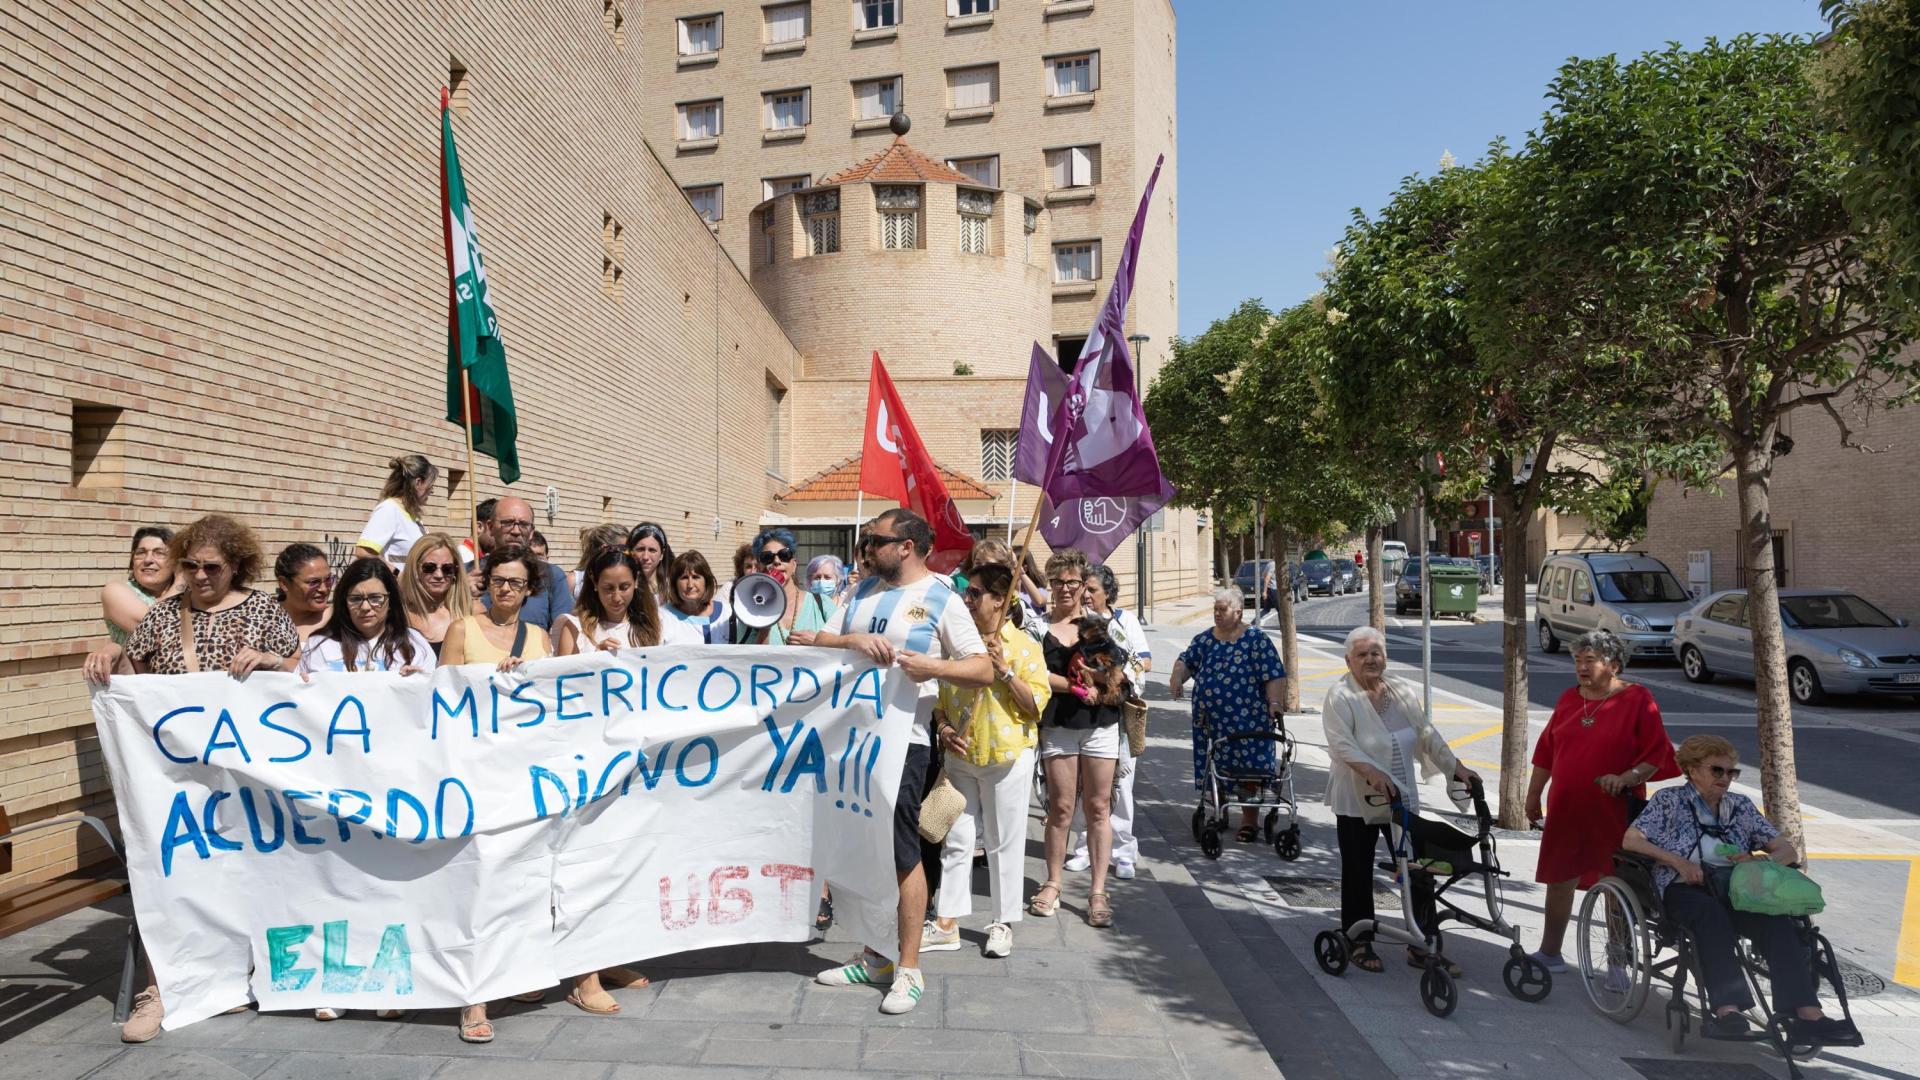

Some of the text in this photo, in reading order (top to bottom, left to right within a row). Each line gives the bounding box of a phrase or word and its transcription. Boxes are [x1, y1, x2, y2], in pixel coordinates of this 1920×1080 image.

[869, 616, 888, 634] 10
[152, 694, 371, 765] CASA
[160, 776, 475, 878] ACUERDO
[760, 713, 881, 817] YA!!!
[658, 863, 815, 932] UGT
[266, 919, 415, 996] ELA
